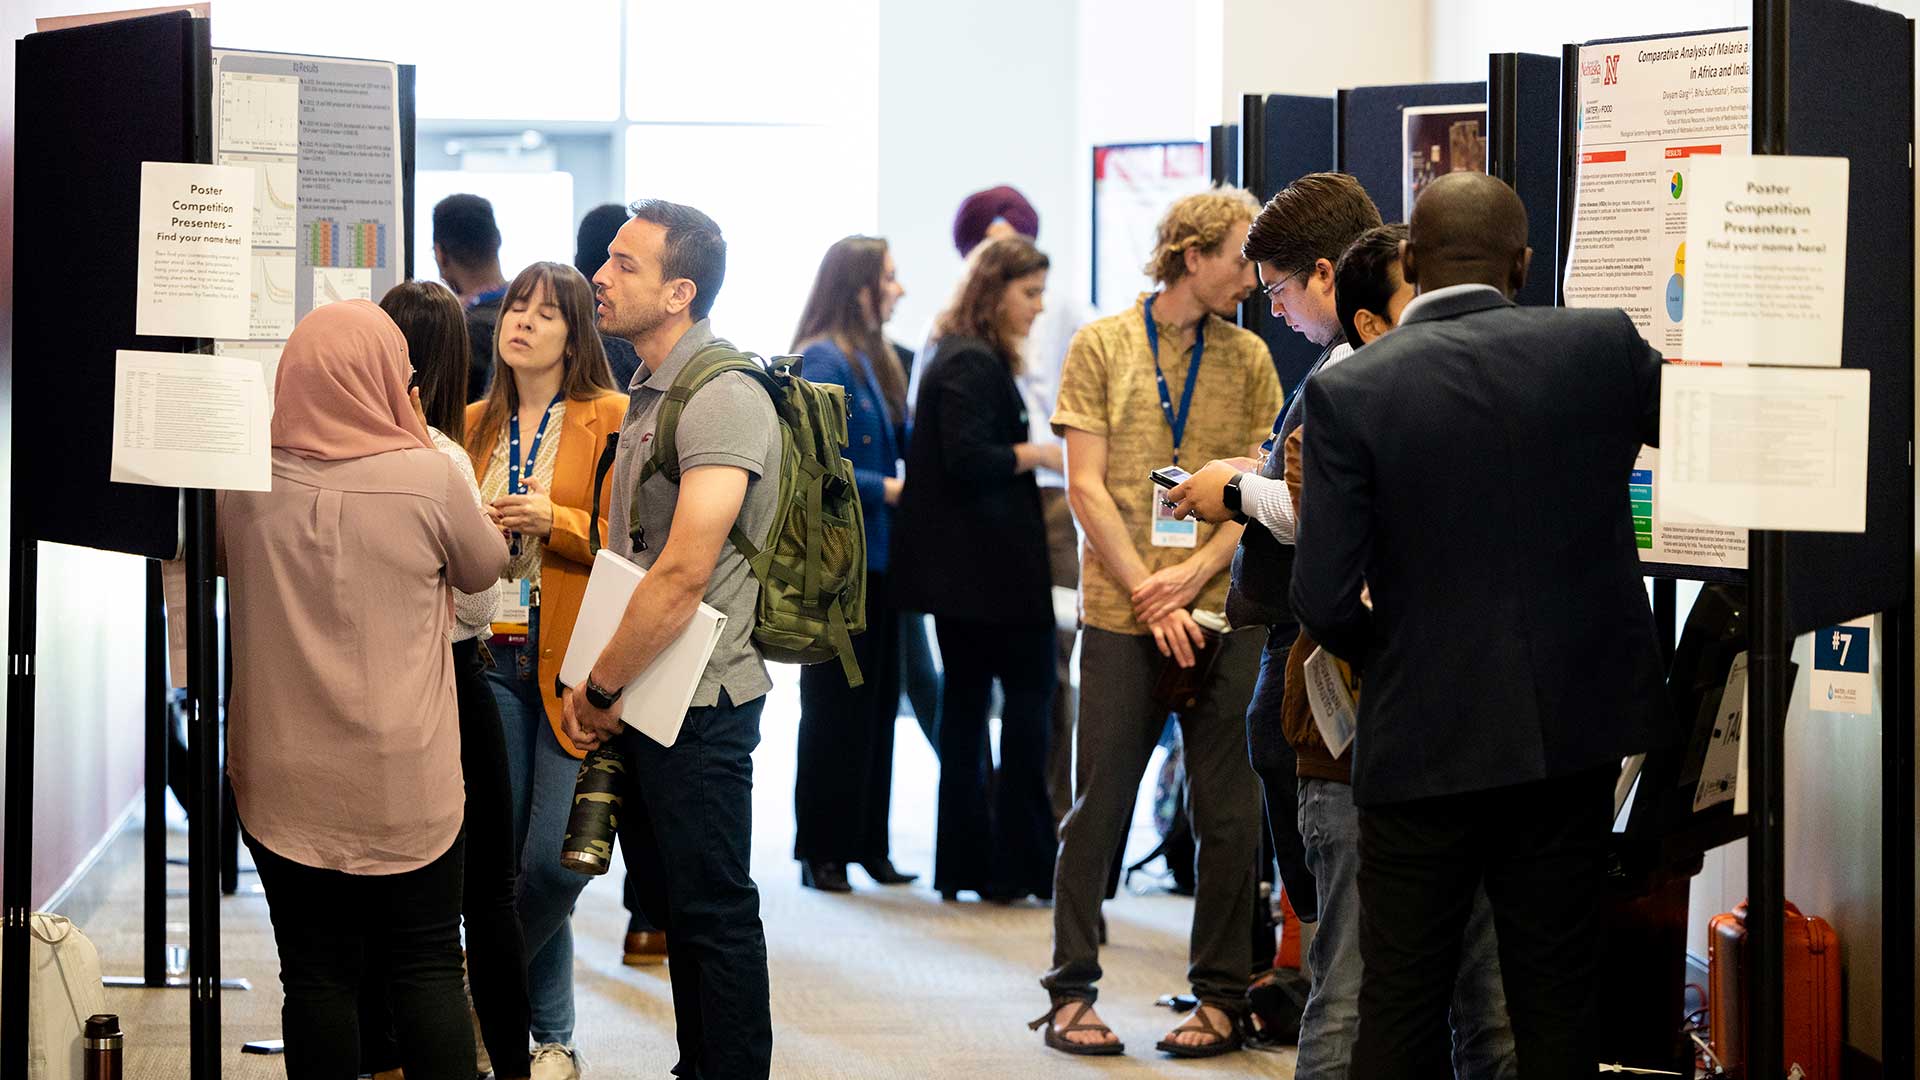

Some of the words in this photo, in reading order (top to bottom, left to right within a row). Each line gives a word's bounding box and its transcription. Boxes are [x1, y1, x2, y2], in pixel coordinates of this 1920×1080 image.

[1638, 48, 1680, 64] Comparative
[1681, 46, 1707, 60] Analysis
[1708, 45, 1717, 56] of
[1718, 42, 1742, 55] Malaria
[1604, 55, 1620, 86] N
[1690, 66, 1697, 80] in
[1698, 65, 1718, 79] Africa
[1719, 65, 1731, 77] and
[190, 184, 223, 196] Poster
[1747, 182, 1790, 195] Poster
[172, 200, 233, 214] Competition
[1725, 202, 1811, 216] Competition
[172, 217, 226, 230] Presenters
[1724, 222, 1797, 236] Presenters
[157, 232, 177, 241] Find
[180, 235, 201, 243] your
[225, 236, 241, 245] here!
[1707, 240, 1730, 250] Find
[1734, 242, 1758, 253] your
[1762, 244, 1794, 253] name
[1798, 243, 1826, 254] here!
[1832, 630, 1852, 667] #7
